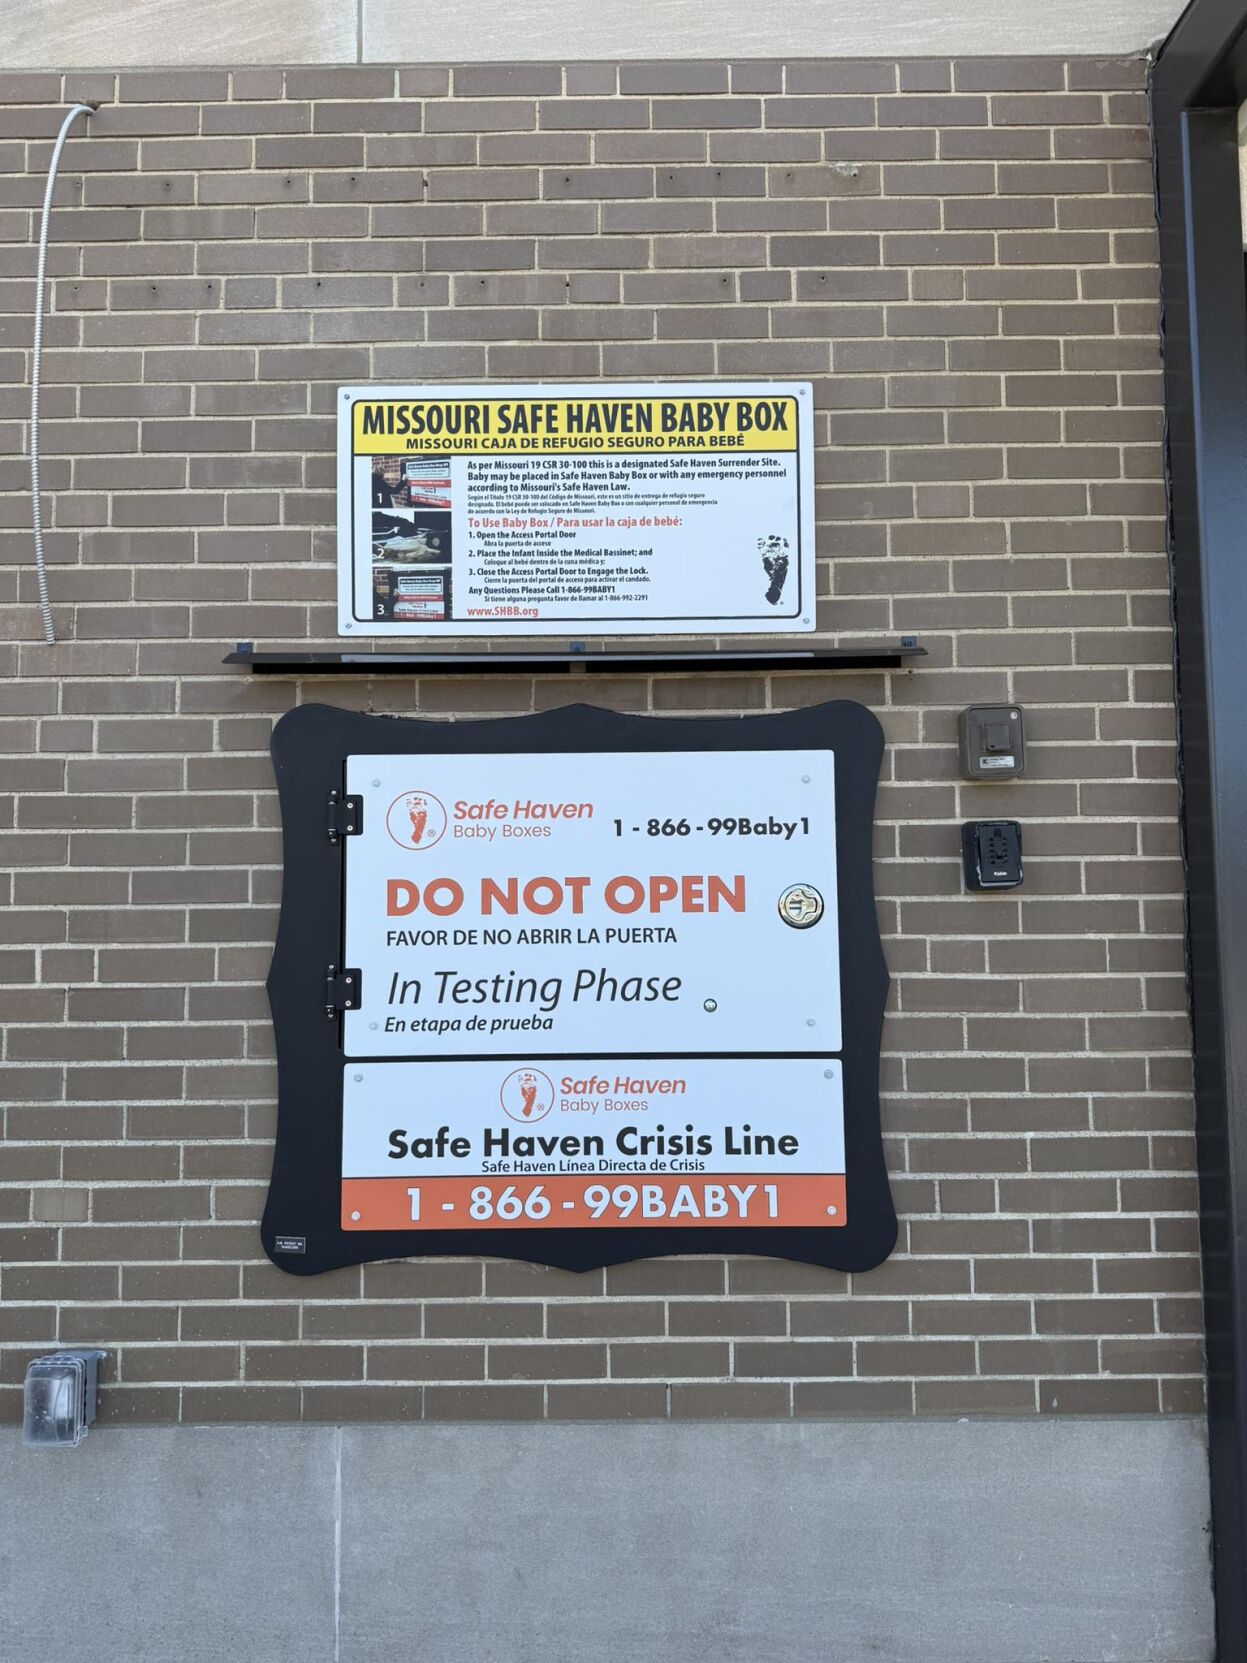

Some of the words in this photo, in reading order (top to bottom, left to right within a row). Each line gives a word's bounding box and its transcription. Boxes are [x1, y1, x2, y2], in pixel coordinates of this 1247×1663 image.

[363, 404, 490, 435] MISSOURI
[498, 404, 559, 434] SAFE
[567, 403, 652, 433] HAVEN
[661, 402, 730, 433] BABY
[737, 401, 788, 434] BOX
[406, 438, 478, 450] MISSOURI
[481, 437, 517, 449] CAJA
[520, 438, 539, 448] DE
[542, 437, 604, 448] REFUGIO
[608, 436, 665, 447] SEGURO
[668, 436, 706, 446] PARA
[709, 433, 744, 445] BEBÉ
[467, 461, 477, 470] As
[478, 463, 493, 471] per
[494, 460, 529, 469] Missouri
[531, 461, 541, 469] 19
[542, 460, 557, 469] CSR
[559, 460, 587, 469] 30-100
[589, 460, 605, 468] this
[606, 460, 613, 468] is
[621, 459, 668, 470] designated
[670, 459, 689, 468] Safe
[690, 459, 717, 467] Haven
[718, 458, 760, 467] Surrender
[761, 458, 781, 466] Site.
[468, 472, 489, 482] Baby
[490, 474, 508, 482] may
[510, 472, 520, 480] be
[522, 471, 549, 482] placed
[551, 472, 559, 480] in
[561, 471, 579, 480] Safe
[581, 471, 607, 480] Haven
[609, 471, 630, 481] Baby
[631, 470, 647, 479] Box
[659, 470, 679, 479] with
[680, 472, 696, 480] any
[697, 471, 744, 480] emergency
[745, 468, 787, 480] personnel
[468, 483, 508, 493] according
[520, 483, 561, 492] Missouri's
[562, 482, 581, 491] Safe
[582, 482, 609, 491] Haven
[610, 482, 630, 491] Law.
[377, 493, 383, 504] 1
[468, 518, 480, 528] To
[482, 517, 500, 528] Use
[502, 517, 528, 530] Baby
[530, 517, 549, 528] Box
[550, 517, 555, 528] /
[557, 517, 580, 528] Para
[606, 516, 615, 527] la
[617, 516, 637, 529] caja
[639, 516, 652, 526] de
[654, 515, 683, 526] bebé:
[476, 531, 496, 539] Open
[377, 548, 384, 559] 2
[604, 548, 637, 557] Bassinet;
[587, 567, 614, 575] Engage
[468, 586, 483, 595] Any
[484, 586, 520, 595] Questions
[561, 585, 615, 594] 1-866-99BABY1
[377, 604, 385, 615] 3
[467, 606, 538, 617] www.SHBB.org
[454, 799, 509, 820] Safe
[513, 800, 594, 819] Haven
[454, 823, 497, 842] Baby
[503, 823, 551, 838] Boxes
[614, 819, 622, 837] 1
[647, 818, 691, 837] 866
[707, 816, 809, 840] 99Baby1
[387, 877, 464, 917] DO
[481, 876, 591, 916] NOT
[604, 874, 746, 914] OPEN
[387, 930, 448, 946] FAVOR
[453, 930, 478, 945] DE
[483, 929, 512, 945] NO
[517, 928, 572, 944] ABRIR
[577, 928, 600, 944] LA
[606, 927, 677, 944] PUERTA
[388, 972, 421, 1004] In
[435, 970, 562, 1012] Testing
[573, 967, 682, 1002] Phase
[384, 1017, 406, 1032] En
[410, 1017, 462, 1034] etapa
[466, 1015, 487, 1031] de
[490, 1014, 553, 1033] prueba
[560, 1075, 610, 1095] Safe
[614, 1076, 686, 1094] Haven
[561, 1098, 599, 1115] Baby
[604, 1098, 648, 1111] Boxes
[388, 1126, 471, 1159] Safe
[484, 1127, 604, 1157] Haven
[616, 1124, 712, 1156] Crisis
[725, 1124, 799, 1156] Line
[482, 1160, 510, 1173] Safe
[514, 1160, 556, 1172] Haven
[559, 1159, 595, 1172] Línea
[599, 1159, 646, 1171] Directa
[650, 1158, 667, 1171] de
[670, 1158, 705, 1171] Crisis
[407, 1188, 420, 1220] 1
[470, 1185, 551, 1220] 866
[584, 1182, 778, 1220] 99BABY1
